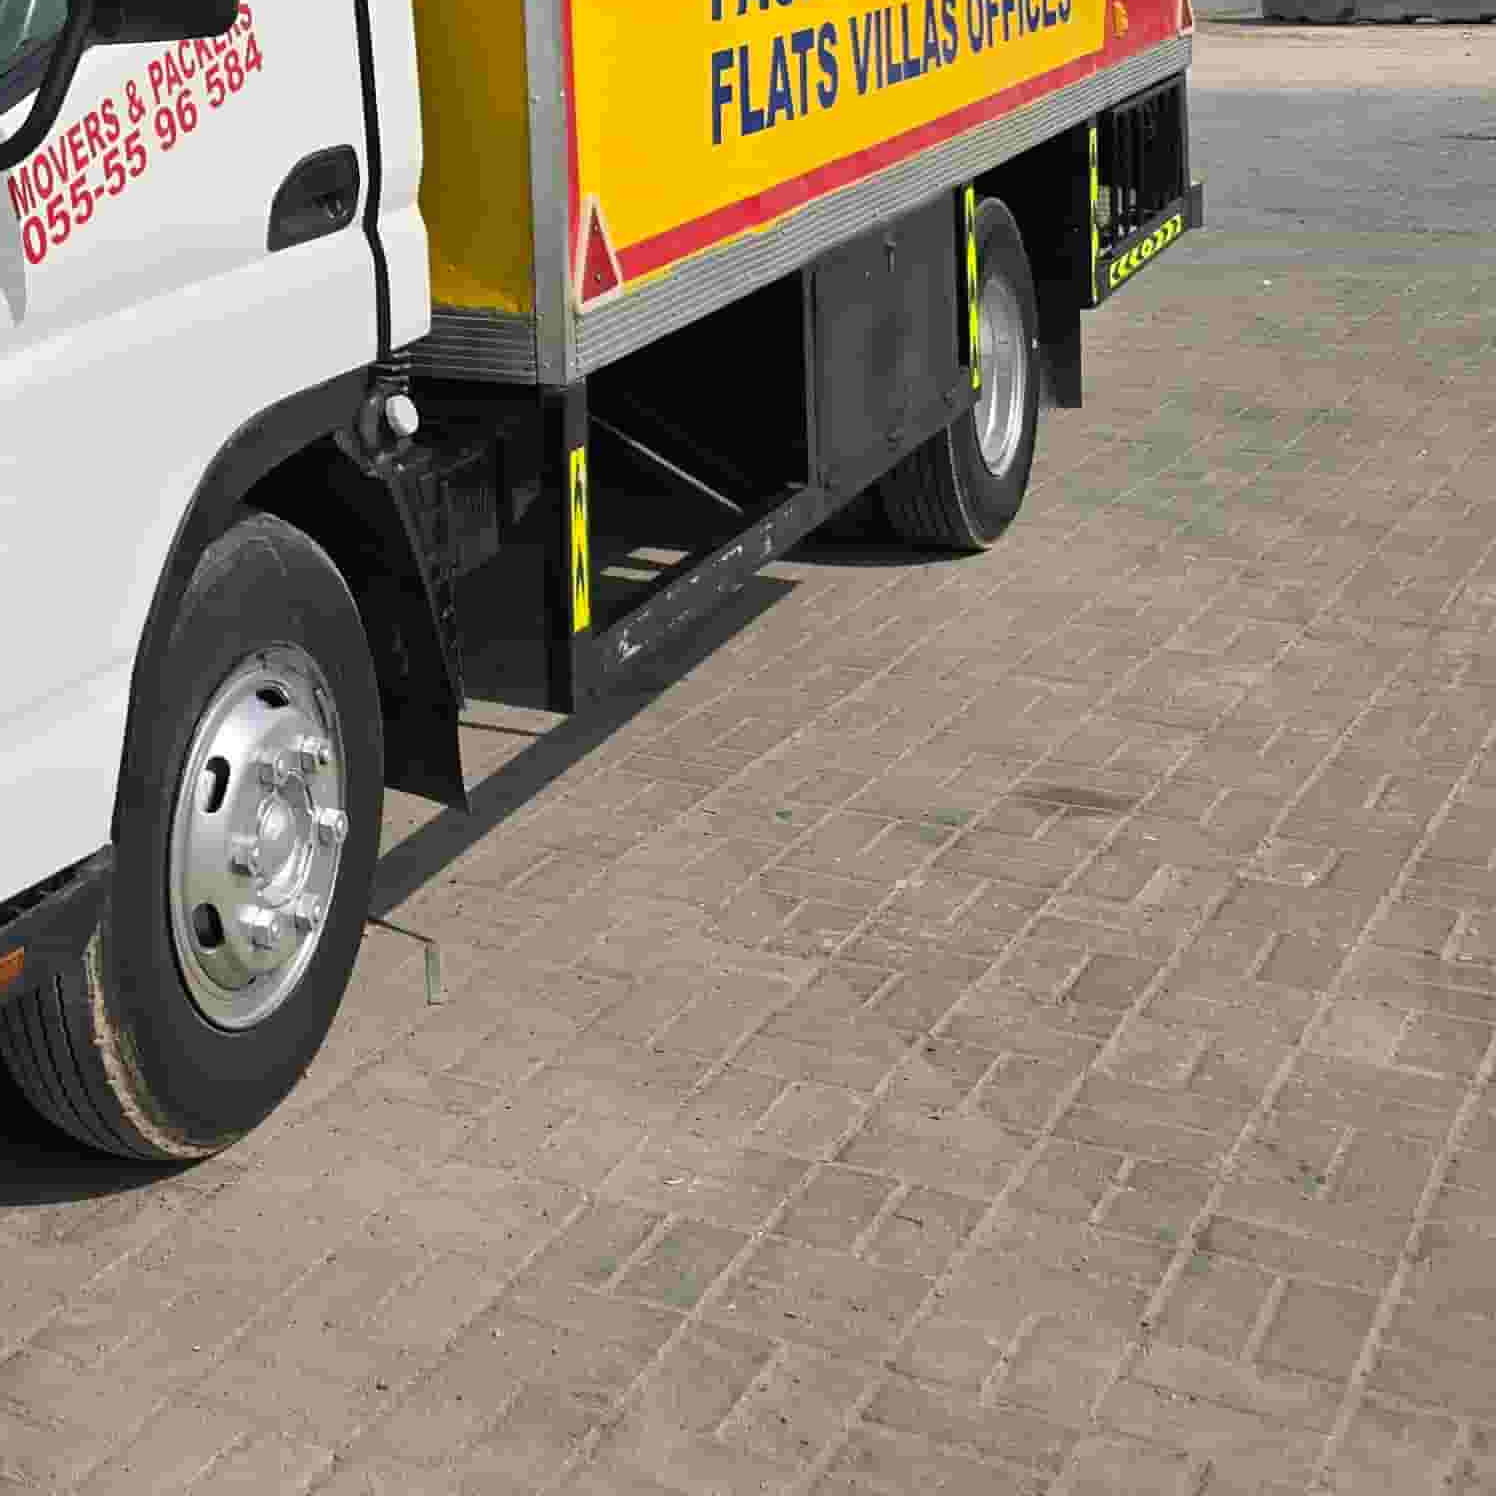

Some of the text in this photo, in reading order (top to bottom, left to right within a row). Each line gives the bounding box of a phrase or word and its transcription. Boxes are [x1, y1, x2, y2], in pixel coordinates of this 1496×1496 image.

[6, 98, 121, 220] MOVERS
[125, 79, 147, 125] &
[22, 31, 263, 265] 055-55 96 584
[710, 21, 839, 145] FLATS
